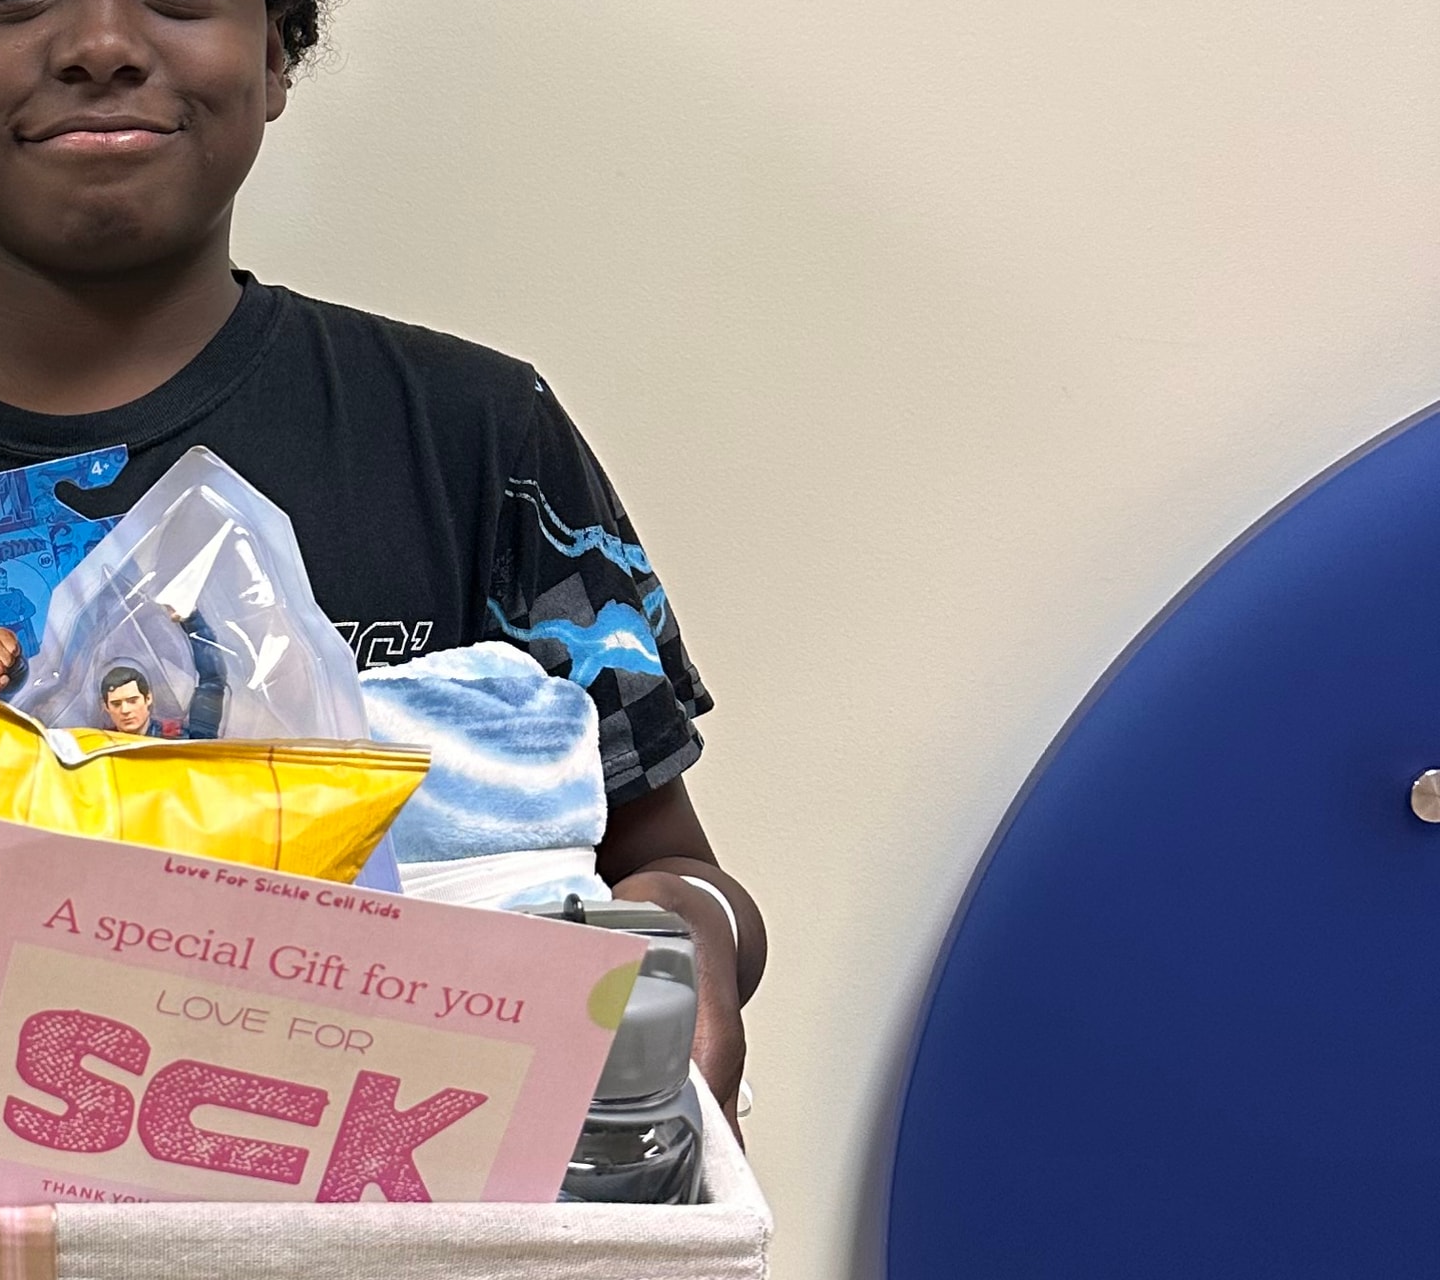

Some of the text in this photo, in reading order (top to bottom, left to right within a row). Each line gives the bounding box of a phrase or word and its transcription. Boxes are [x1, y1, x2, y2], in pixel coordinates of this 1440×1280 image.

[164, 857, 401, 920] Love For Sickle Cell Kids
[42, 898, 525, 1024] A special Gift for you
[156, 989, 374, 1055] LOVE FOR
[3, 1008, 490, 1203] SCK
[41, 1179, 106, 1202] THANK
